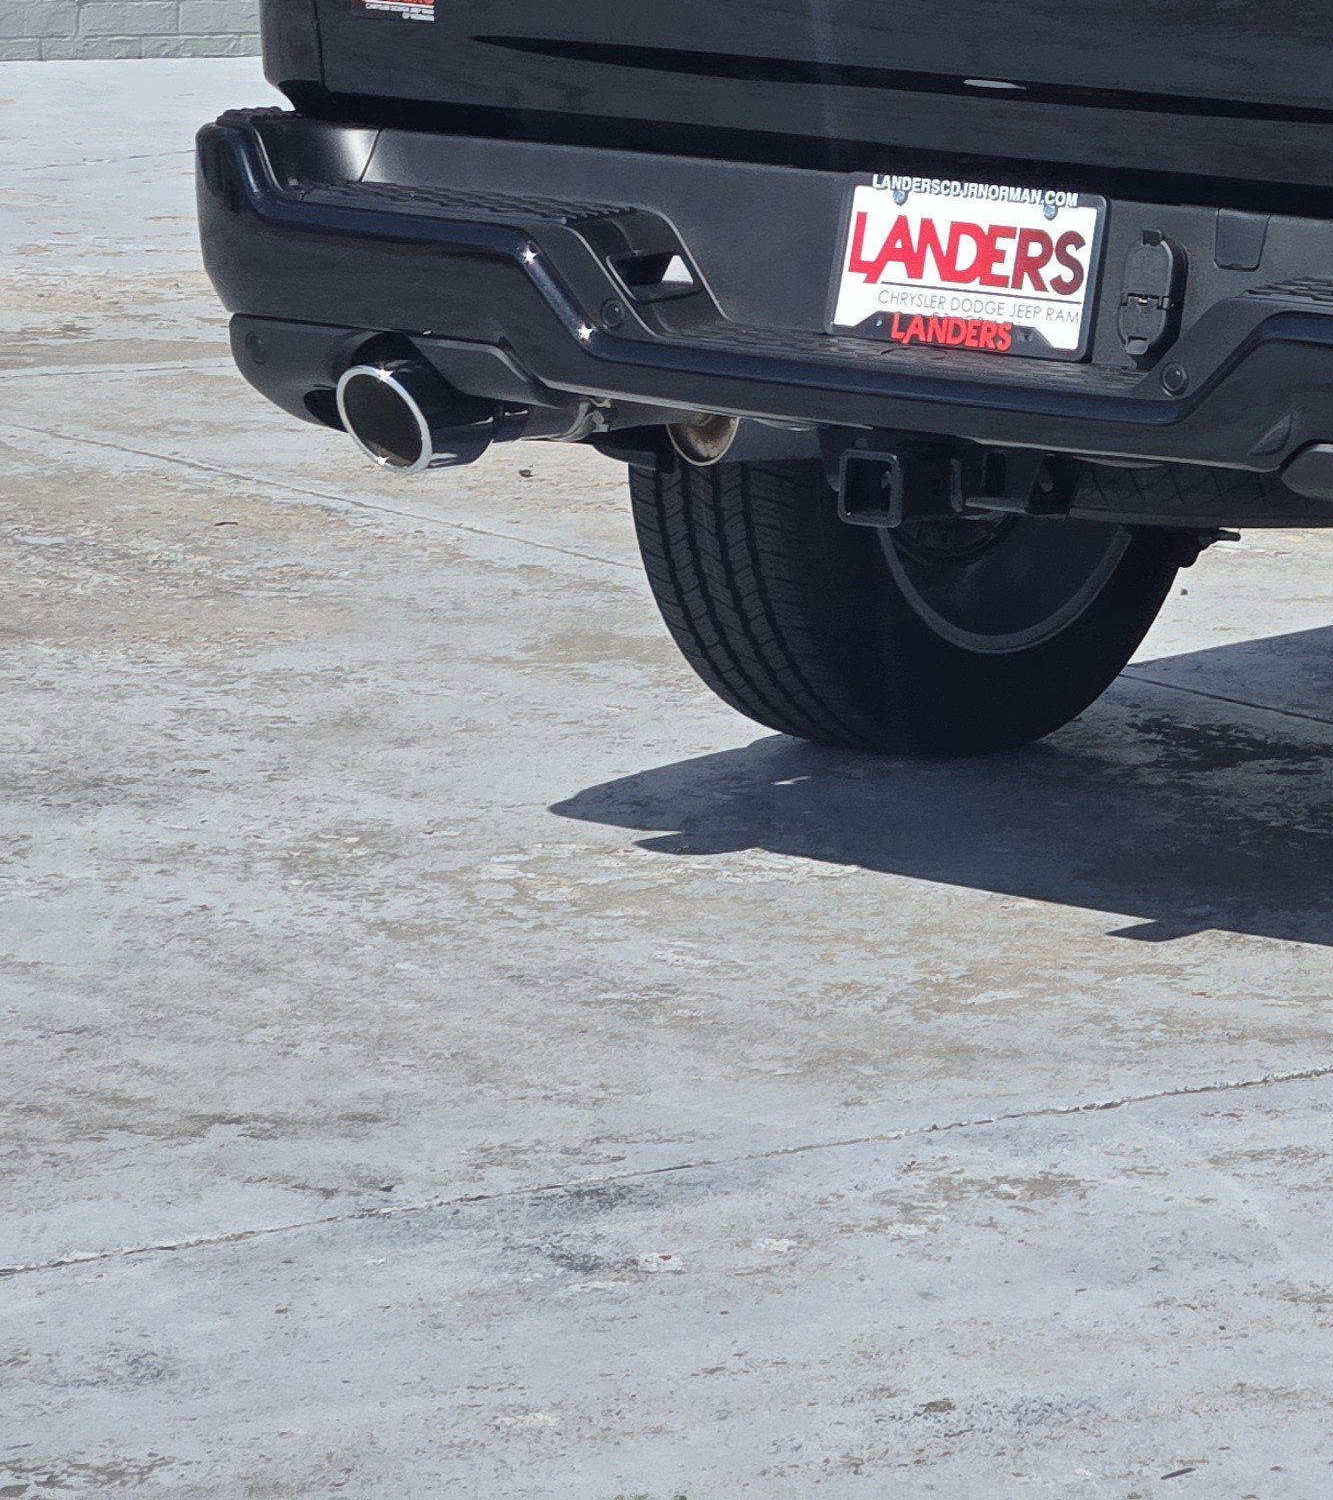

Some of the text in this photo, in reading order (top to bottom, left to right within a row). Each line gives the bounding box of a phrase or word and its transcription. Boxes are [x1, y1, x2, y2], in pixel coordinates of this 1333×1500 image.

[872, 174, 1079, 206] LANDERSCDJRNORMAN.COM
[848, 211, 1086, 295] LANDERS
[878, 290, 946, 311] CHRYSLER
[950, 298, 1005, 317] DODGE
[1012, 305, 1042, 321] JEEP
[1045, 308, 1079, 324] RAM
[891, 312, 1012, 351] LANDERS
